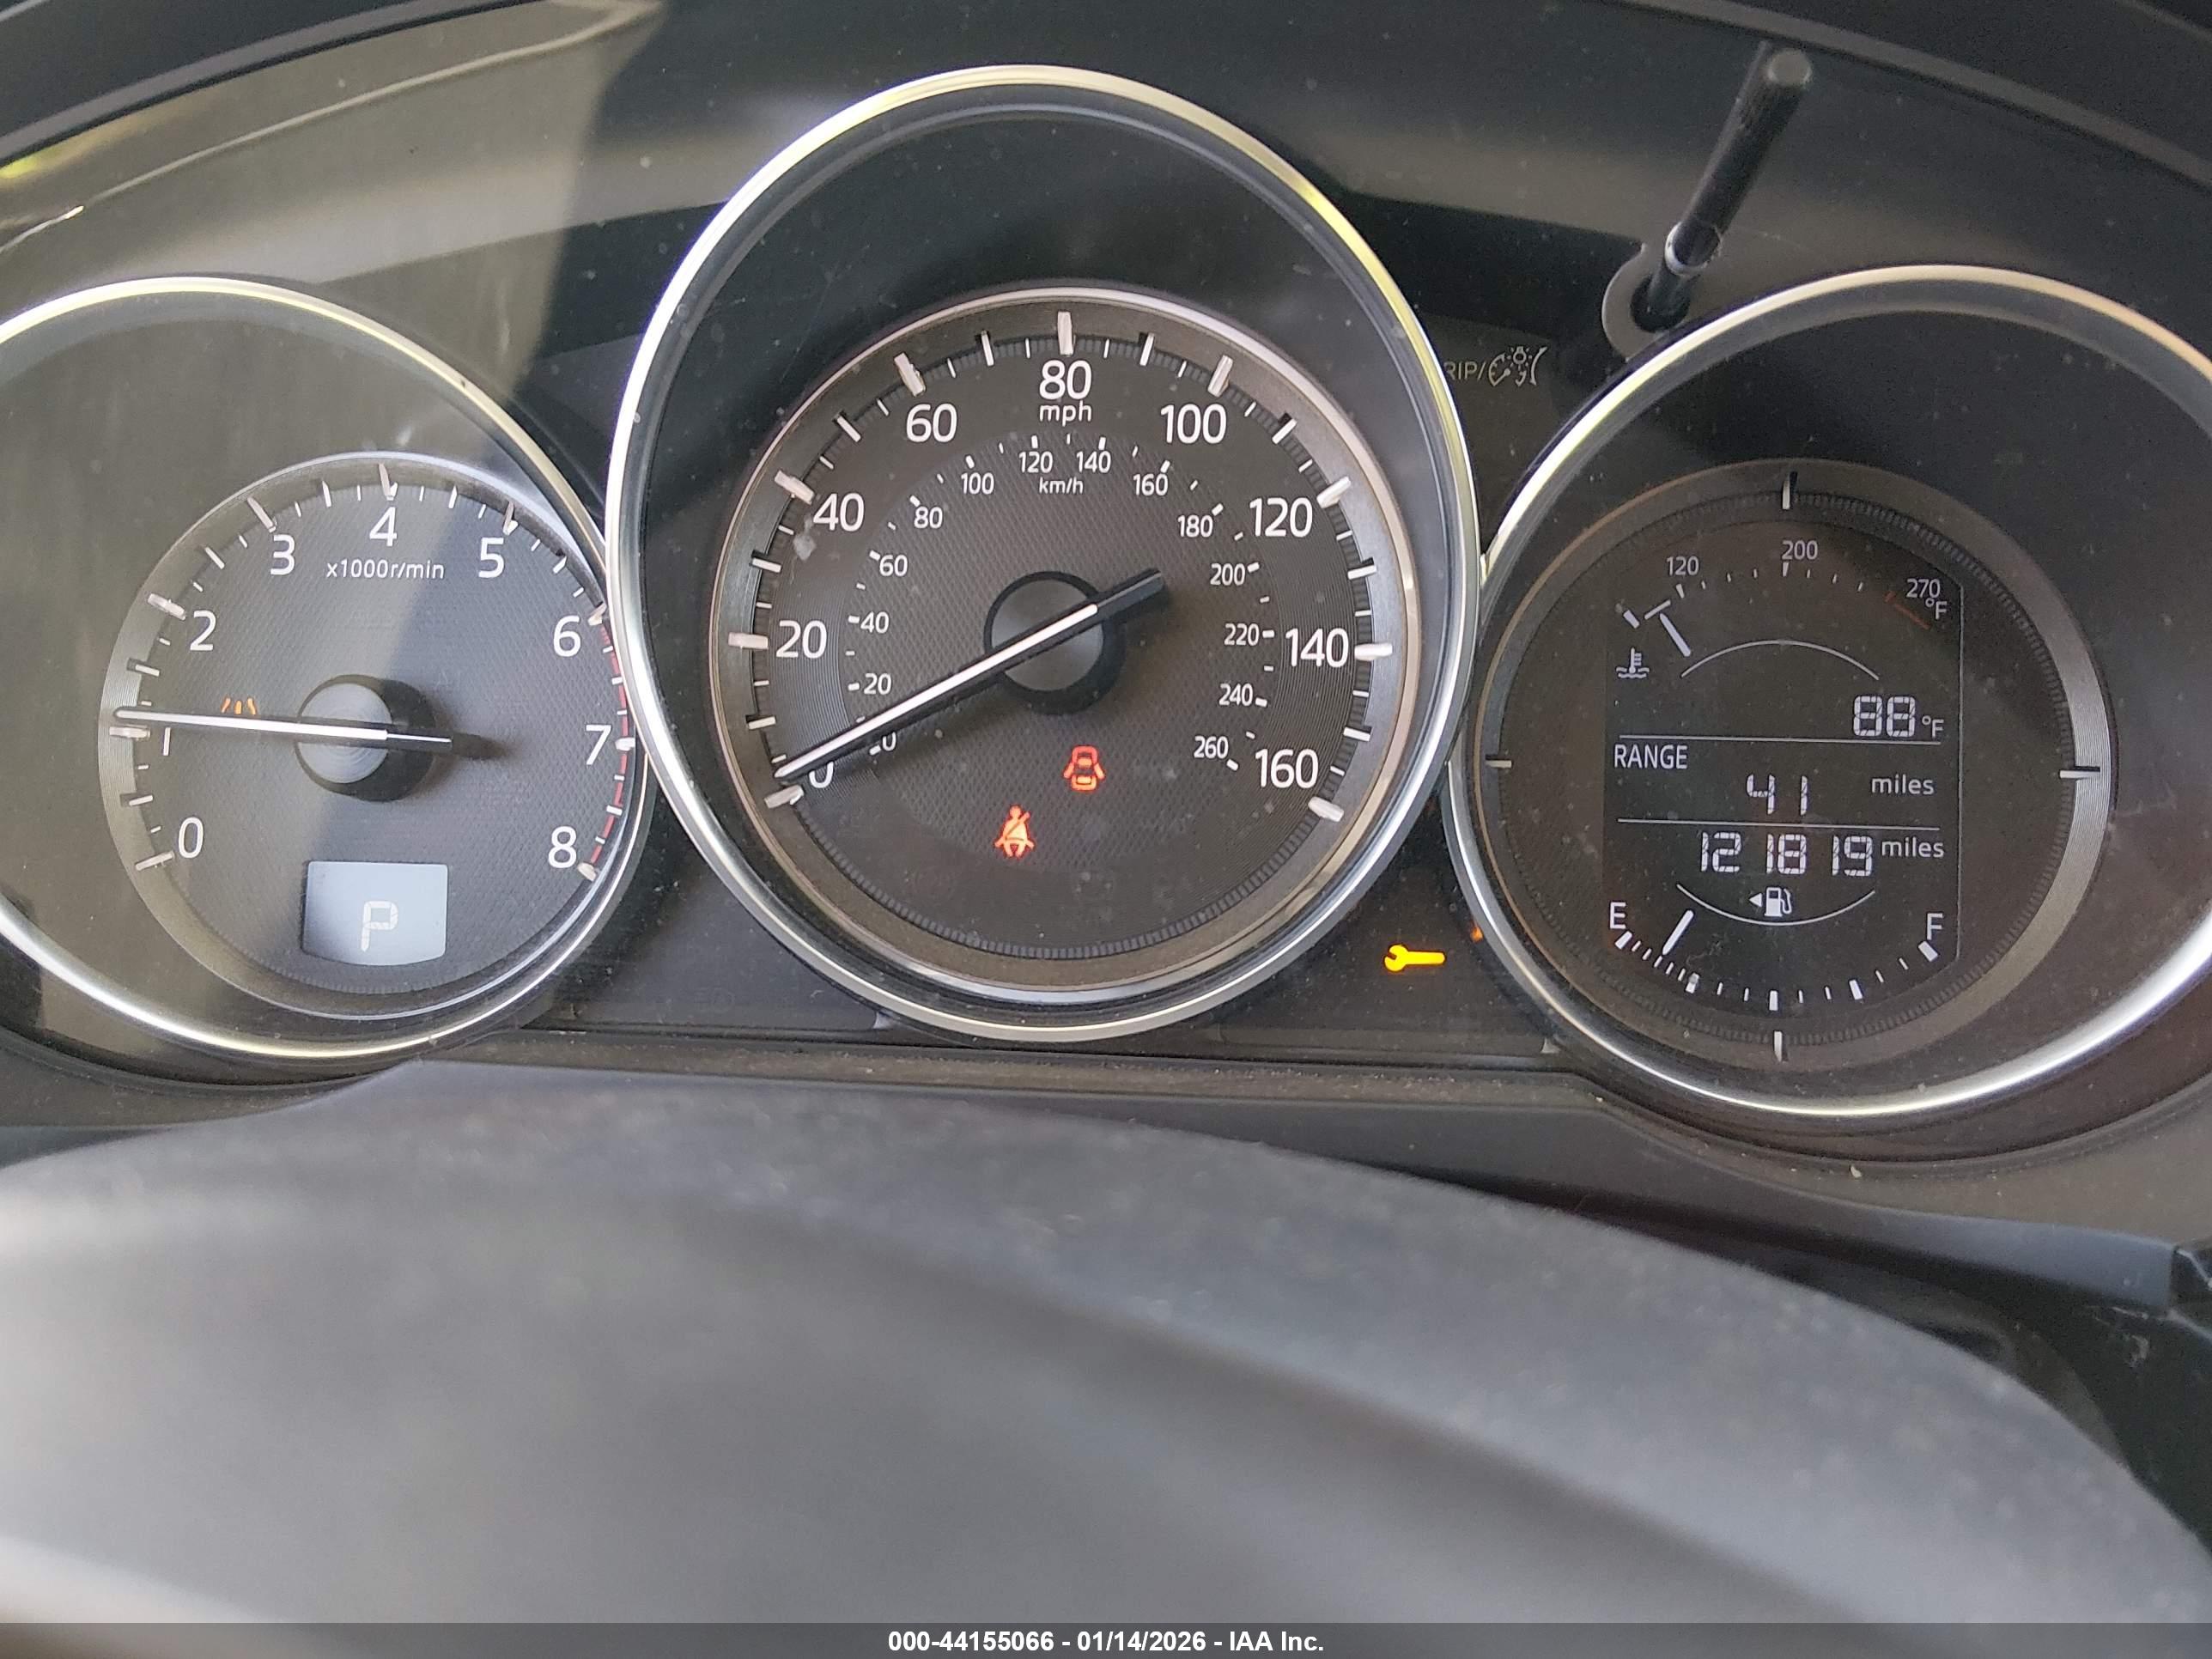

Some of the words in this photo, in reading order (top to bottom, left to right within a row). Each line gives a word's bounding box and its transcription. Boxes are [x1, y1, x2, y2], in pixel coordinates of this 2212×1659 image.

[1039, 359, 1092, 401] 80
[905, 402, 958, 443] 60
[1039, 402, 1092, 426] mph
[1160, 404, 1228, 445] 100
[1018, 451, 1054, 474] 120
[1076, 451, 1111, 474] 140
[961, 471, 995, 495] 100
[1038, 477, 1085, 495] km/h
[1133, 473, 1169, 496] 160
[812, 492, 866, 532] 40
[913, 506, 944, 529] 80
[1249, 497, 1314, 538] 120
[368, 506, 398, 547] 4
[1177, 515, 1213, 538] 180
[269, 533, 297, 576] 3
[477, 536, 505, 579] 5
[1782, 539, 1820, 561] 200
[325, 558, 445, 581] x1000r/min
[878, 554, 908, 577] 60
[1209, 562, 1246, 586] 200
[1667, 556, 1700, 576] 120
[1905, 578, 1942, 599] 270
[189, 611, 215, 652] 2
[552, 615, 582, 658] 6
[860, 611, 890, 635] 40
[1224, 623, 1260, 646] 220
[775, 620, 828, 659] 20
[1285, 627, 1350, 667] 140
[863, 672, 892, 696] 20
[1218, 684, 1255, 708] 240
[585, 724, 612, 767] 7
[1193, 735, 1229, 759] 260
[1613, 743, 1688, 770] RANGE
[1254, 748, 1320, 789] 160
[1746, 774, 1808, 816] 41
[1871, 774, 1935, 795] miles
[177, 817, 204, 860] 0
[547, 825, 578, 868] 8
[1881, 836, 1945, 859] miles
[362, 900, 398, 952] P
[1608, 901, 1627, 930] E
[1926, 912, 1944, 940] F
